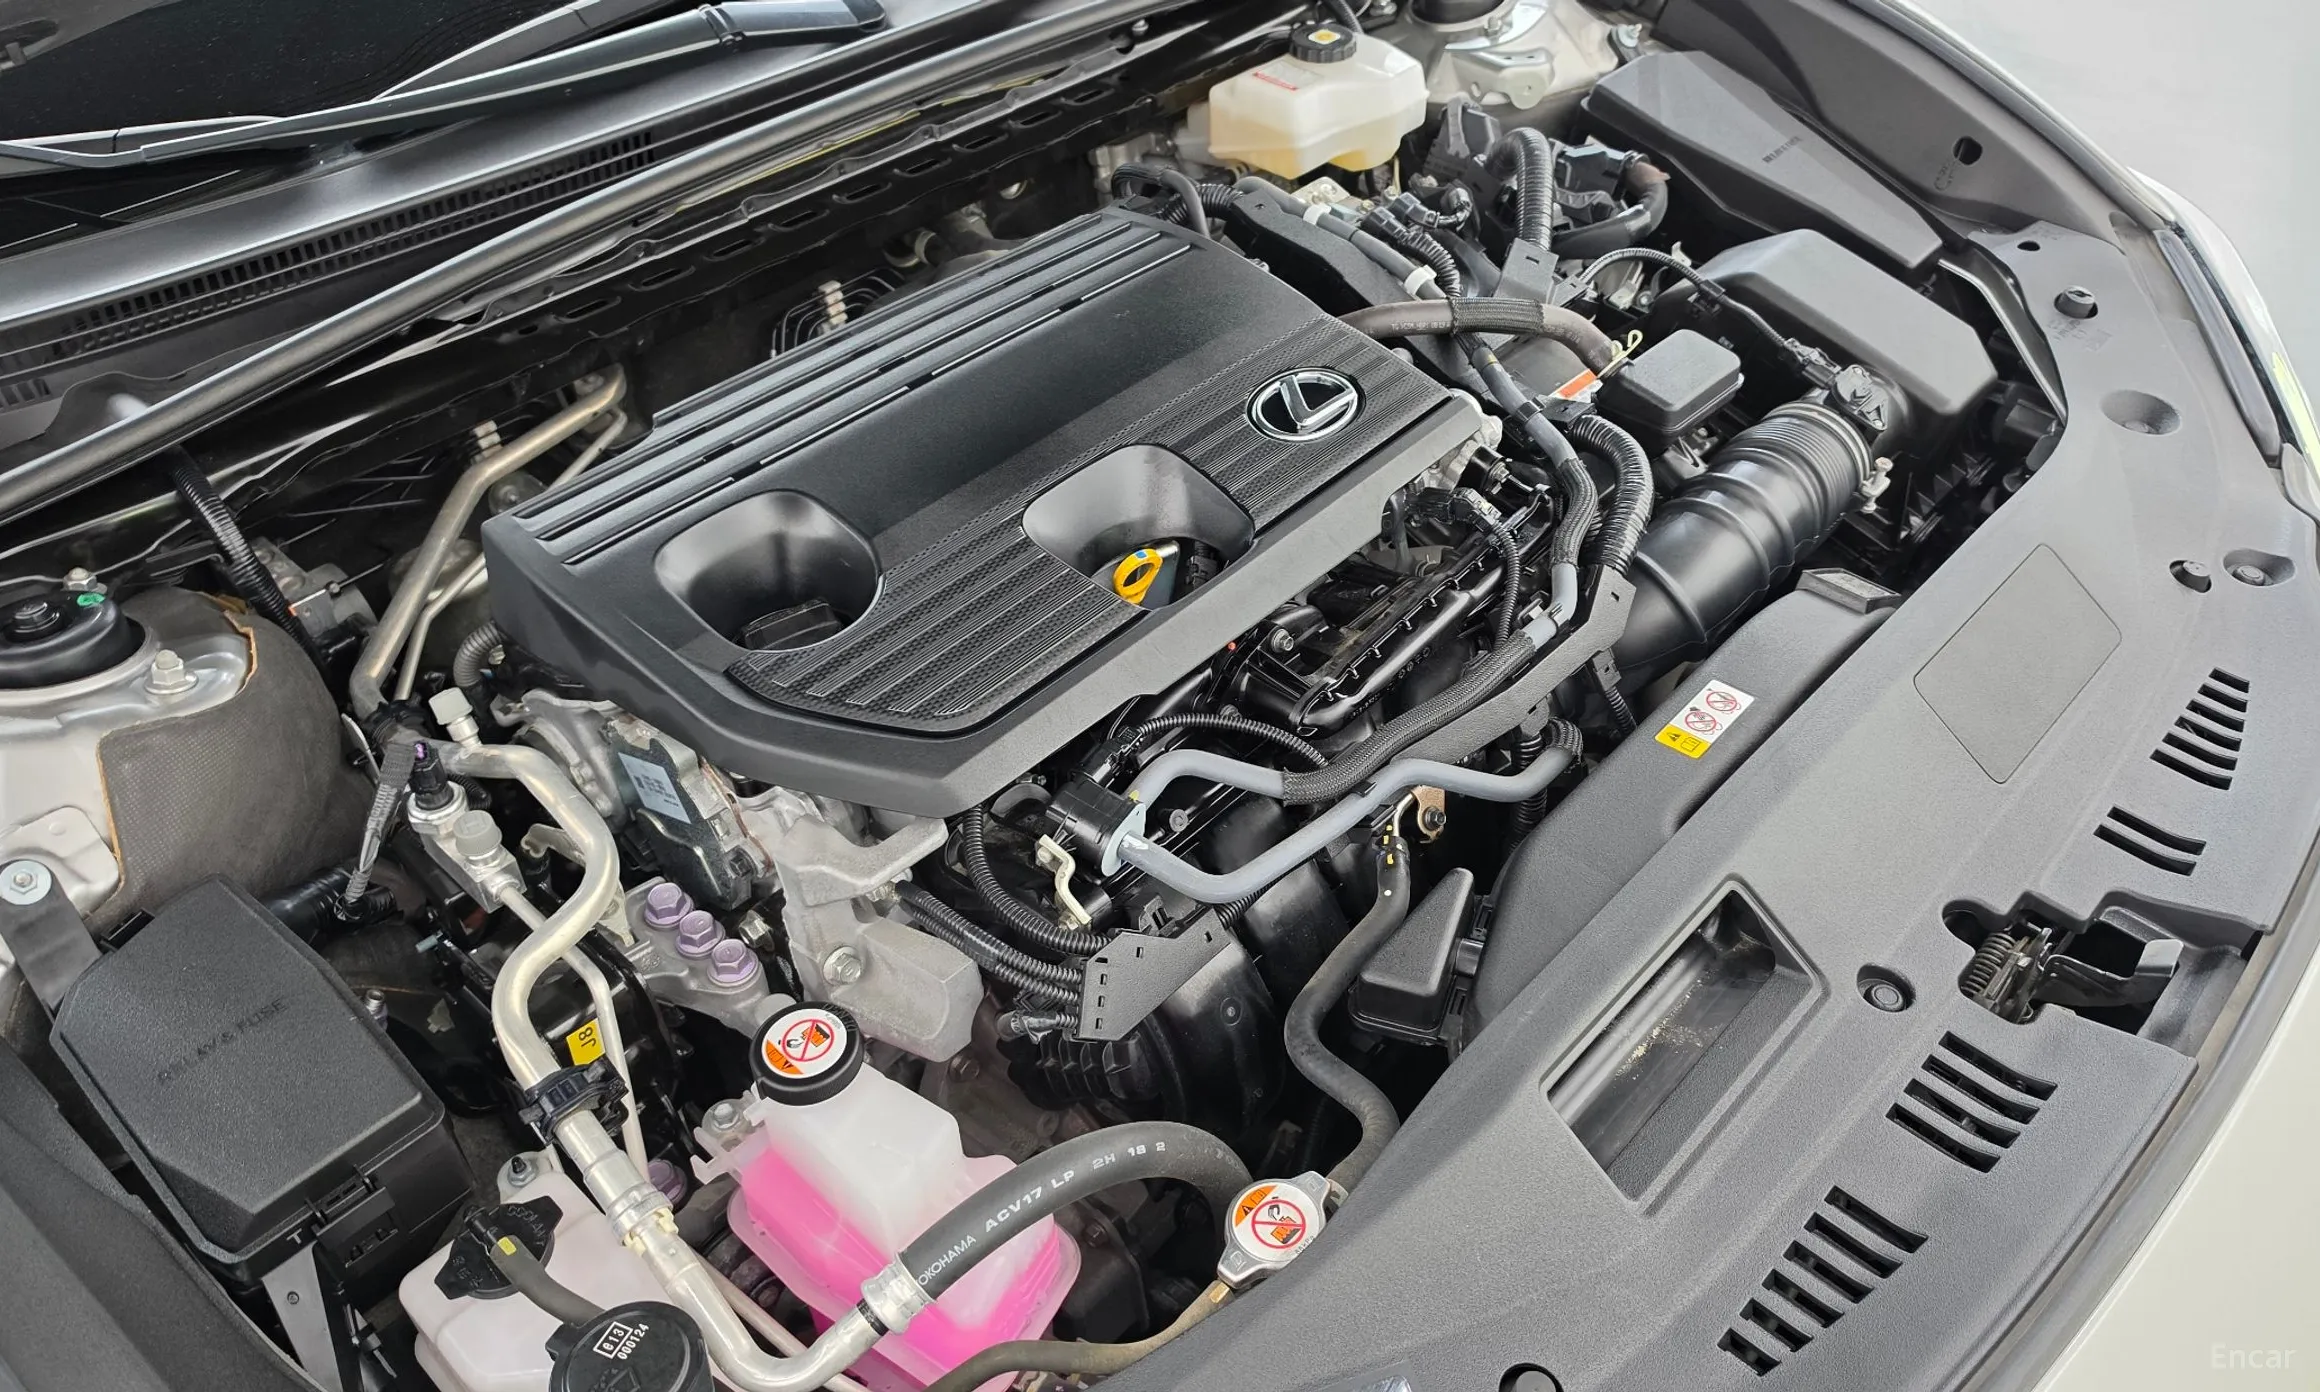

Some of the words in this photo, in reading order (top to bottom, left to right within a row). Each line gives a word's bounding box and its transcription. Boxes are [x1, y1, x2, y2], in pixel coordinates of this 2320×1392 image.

[237, 998, 288, 1035] FUSE
[578, 1026, 597, 1048] J8
[917, 1234, 977, 1286] OKOHAMA
[985, 1186, 1043, 1233] ACV17
[1050, 1169, 1075, 1189] LP
[1092, 1152, 1116, 1170] 2H
[1155, 1141, 1166, 1152] 2
[602, 1327, 625, 1351] e13
[616, 1322, 650, 1360] 000124
